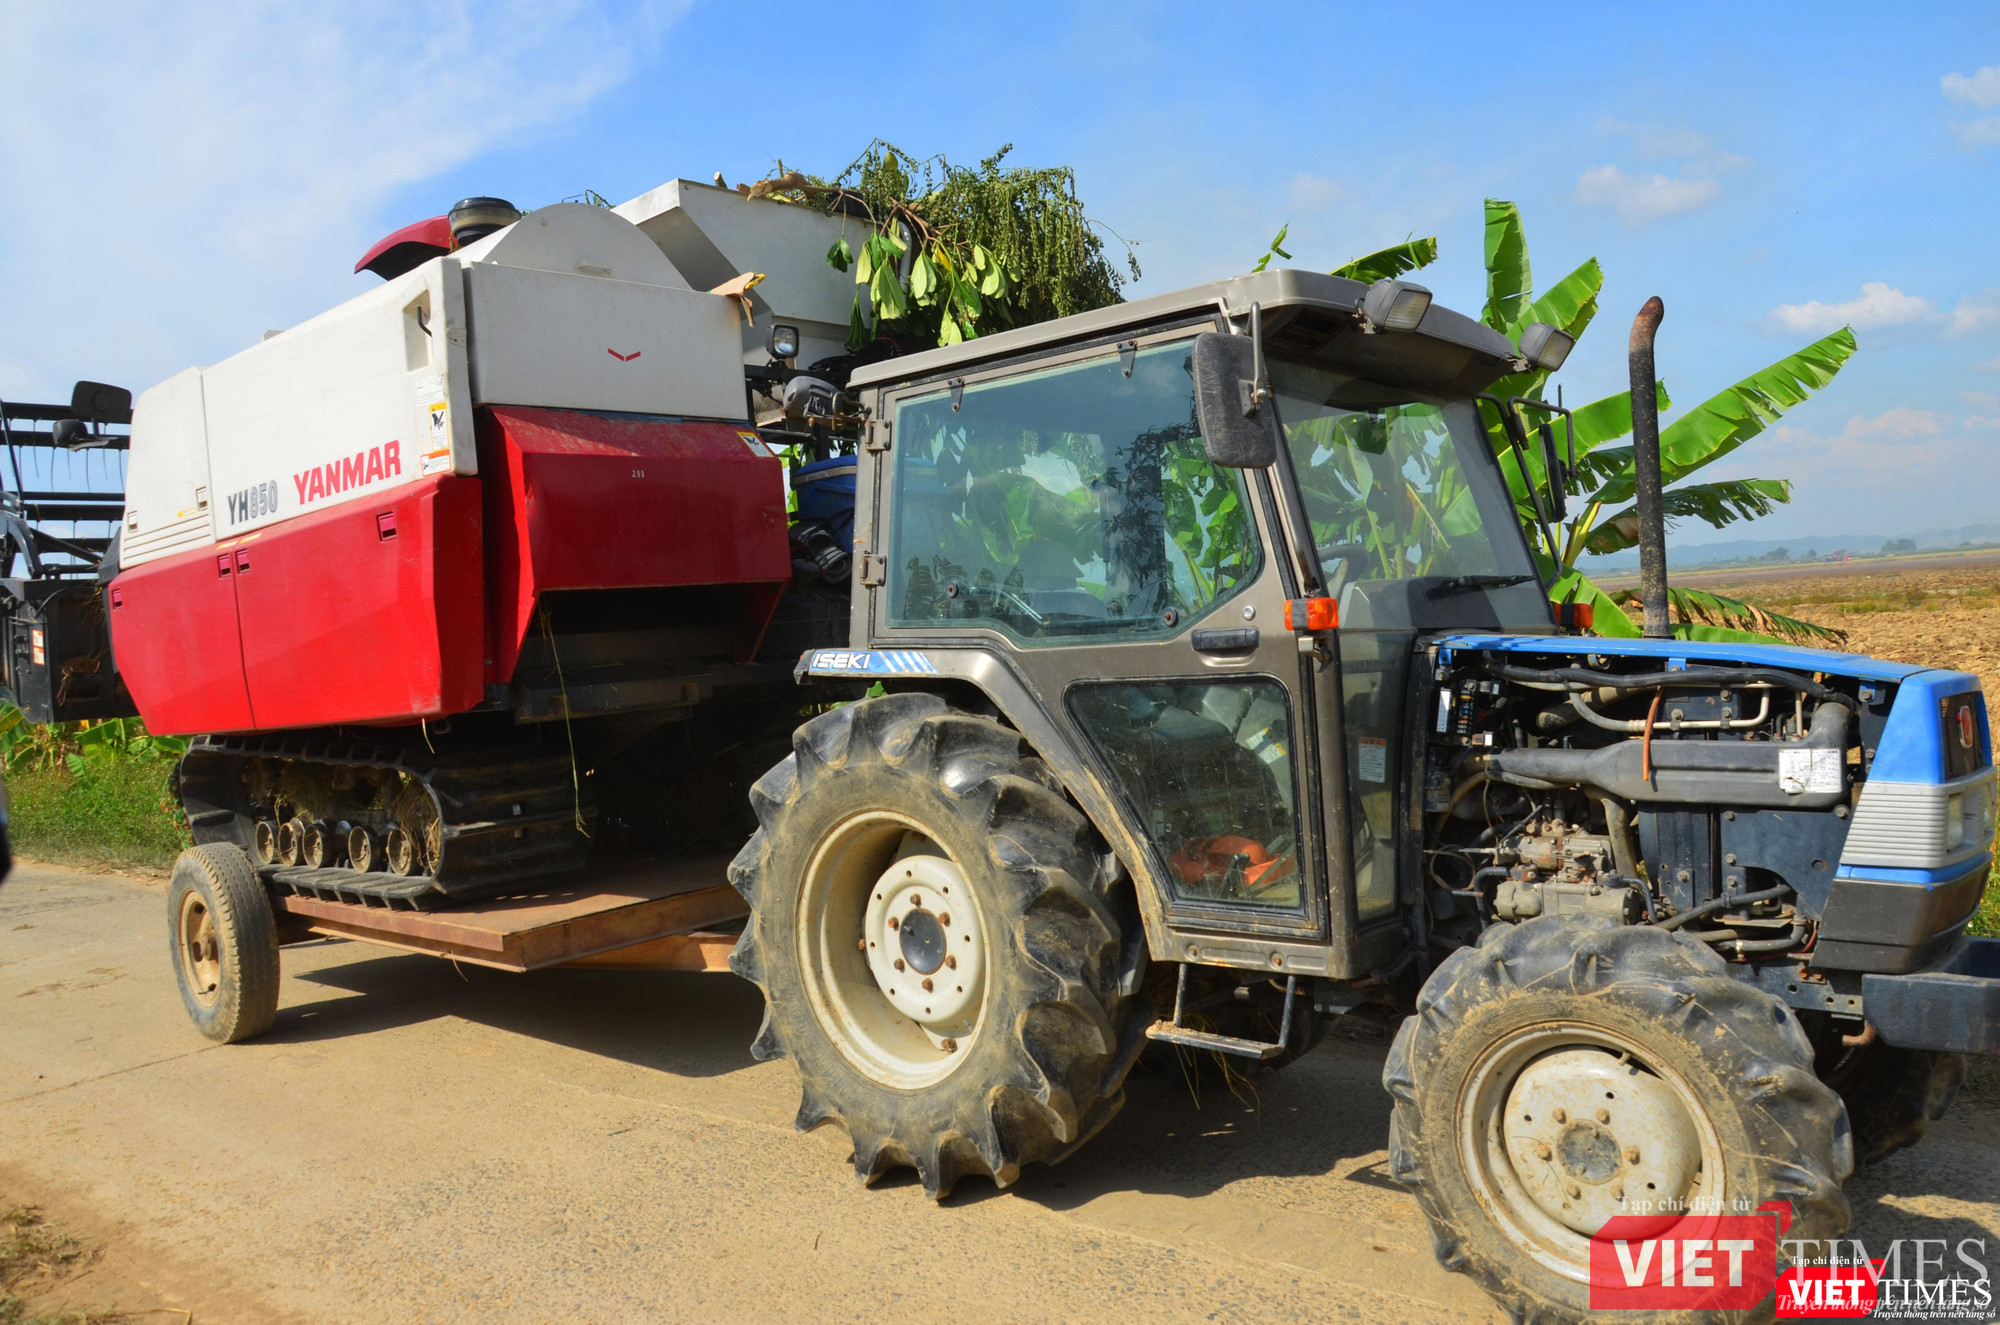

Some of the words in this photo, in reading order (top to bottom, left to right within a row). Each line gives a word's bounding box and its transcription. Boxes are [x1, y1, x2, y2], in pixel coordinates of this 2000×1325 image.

[227, 479, 279, 526] YH850
[293, 439, 402, 506] YANMAR
[812, 652, 871, 670] ISEKI
